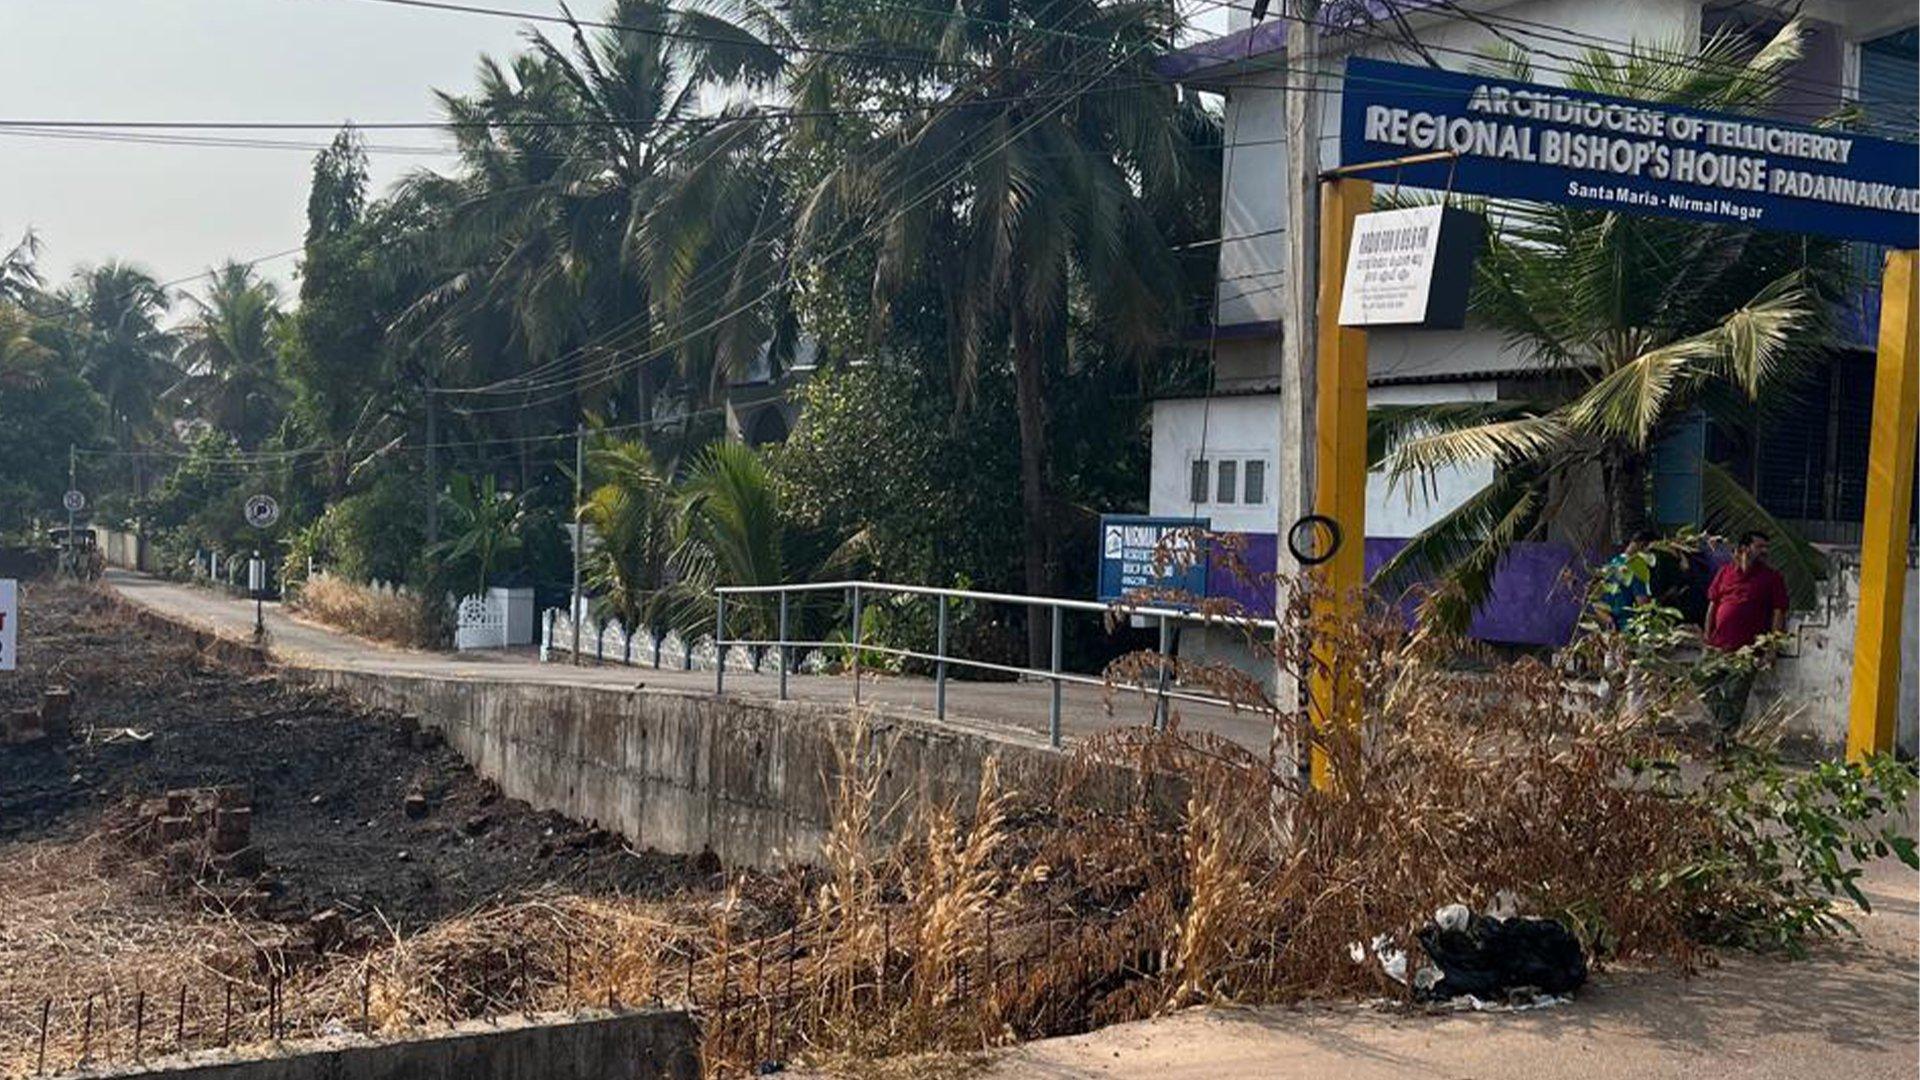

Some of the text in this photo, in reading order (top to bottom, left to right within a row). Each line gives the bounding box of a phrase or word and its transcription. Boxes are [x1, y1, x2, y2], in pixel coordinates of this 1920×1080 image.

[1365, 105, 1537, 162] REGIONAL
[1539, 129, 1670, 179] BISHOP'S
[1671, 148, 1767, 191] HOUSE
[1467, 85, 1853, 163] ARCHDIOCESE OF TELLICHERRY
[1568, 182, 1614, 200] Santa
[1615, 187, 1659, 206] Maria
[1669, 194, 1717, 214] Nirmal
[1719, 202, 1763, 221] Nagar
